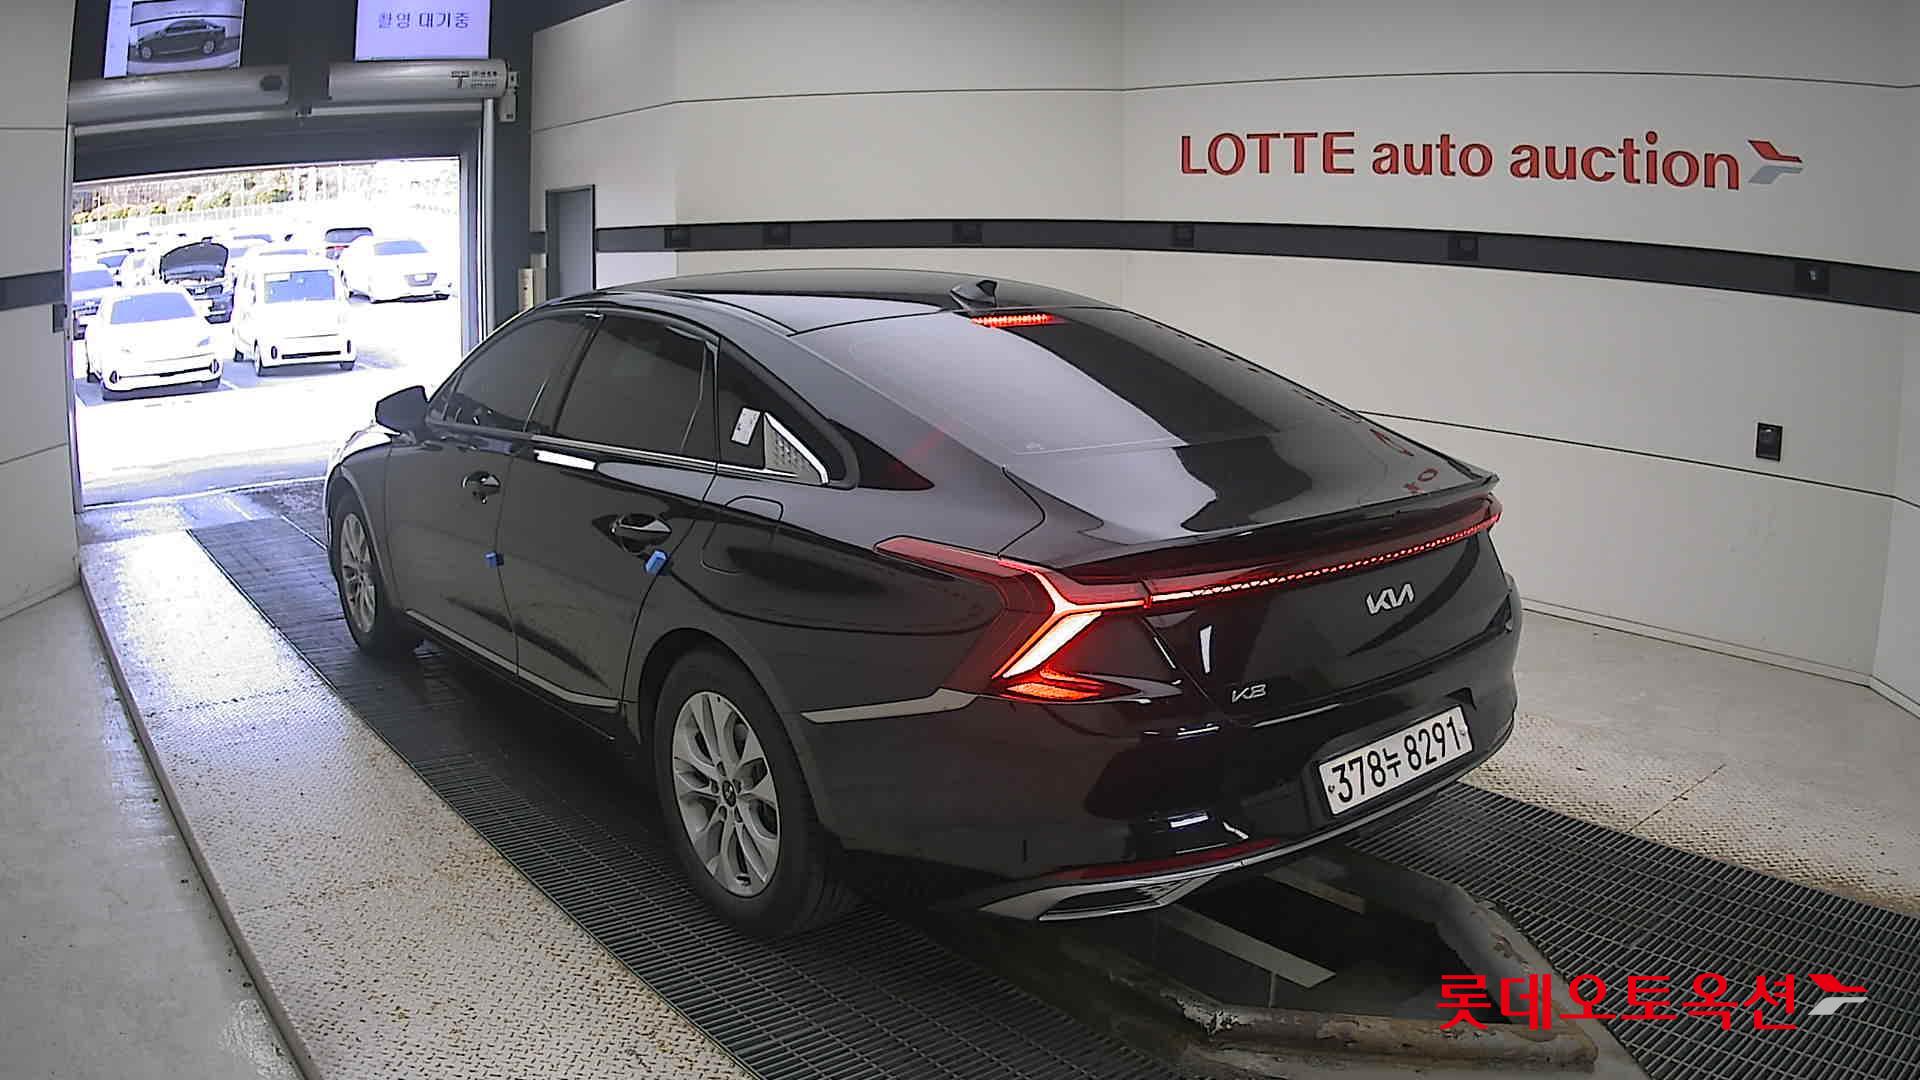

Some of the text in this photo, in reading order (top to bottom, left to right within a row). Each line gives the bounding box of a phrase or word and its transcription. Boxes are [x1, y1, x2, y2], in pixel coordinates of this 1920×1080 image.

[418, 12, 471, 29] 대기중
[1180, 130, 1741, 190] LOTTE auto auction
[1365, 583, 1416, 615] KIA
[1230, 683, 1268, 704] K8
